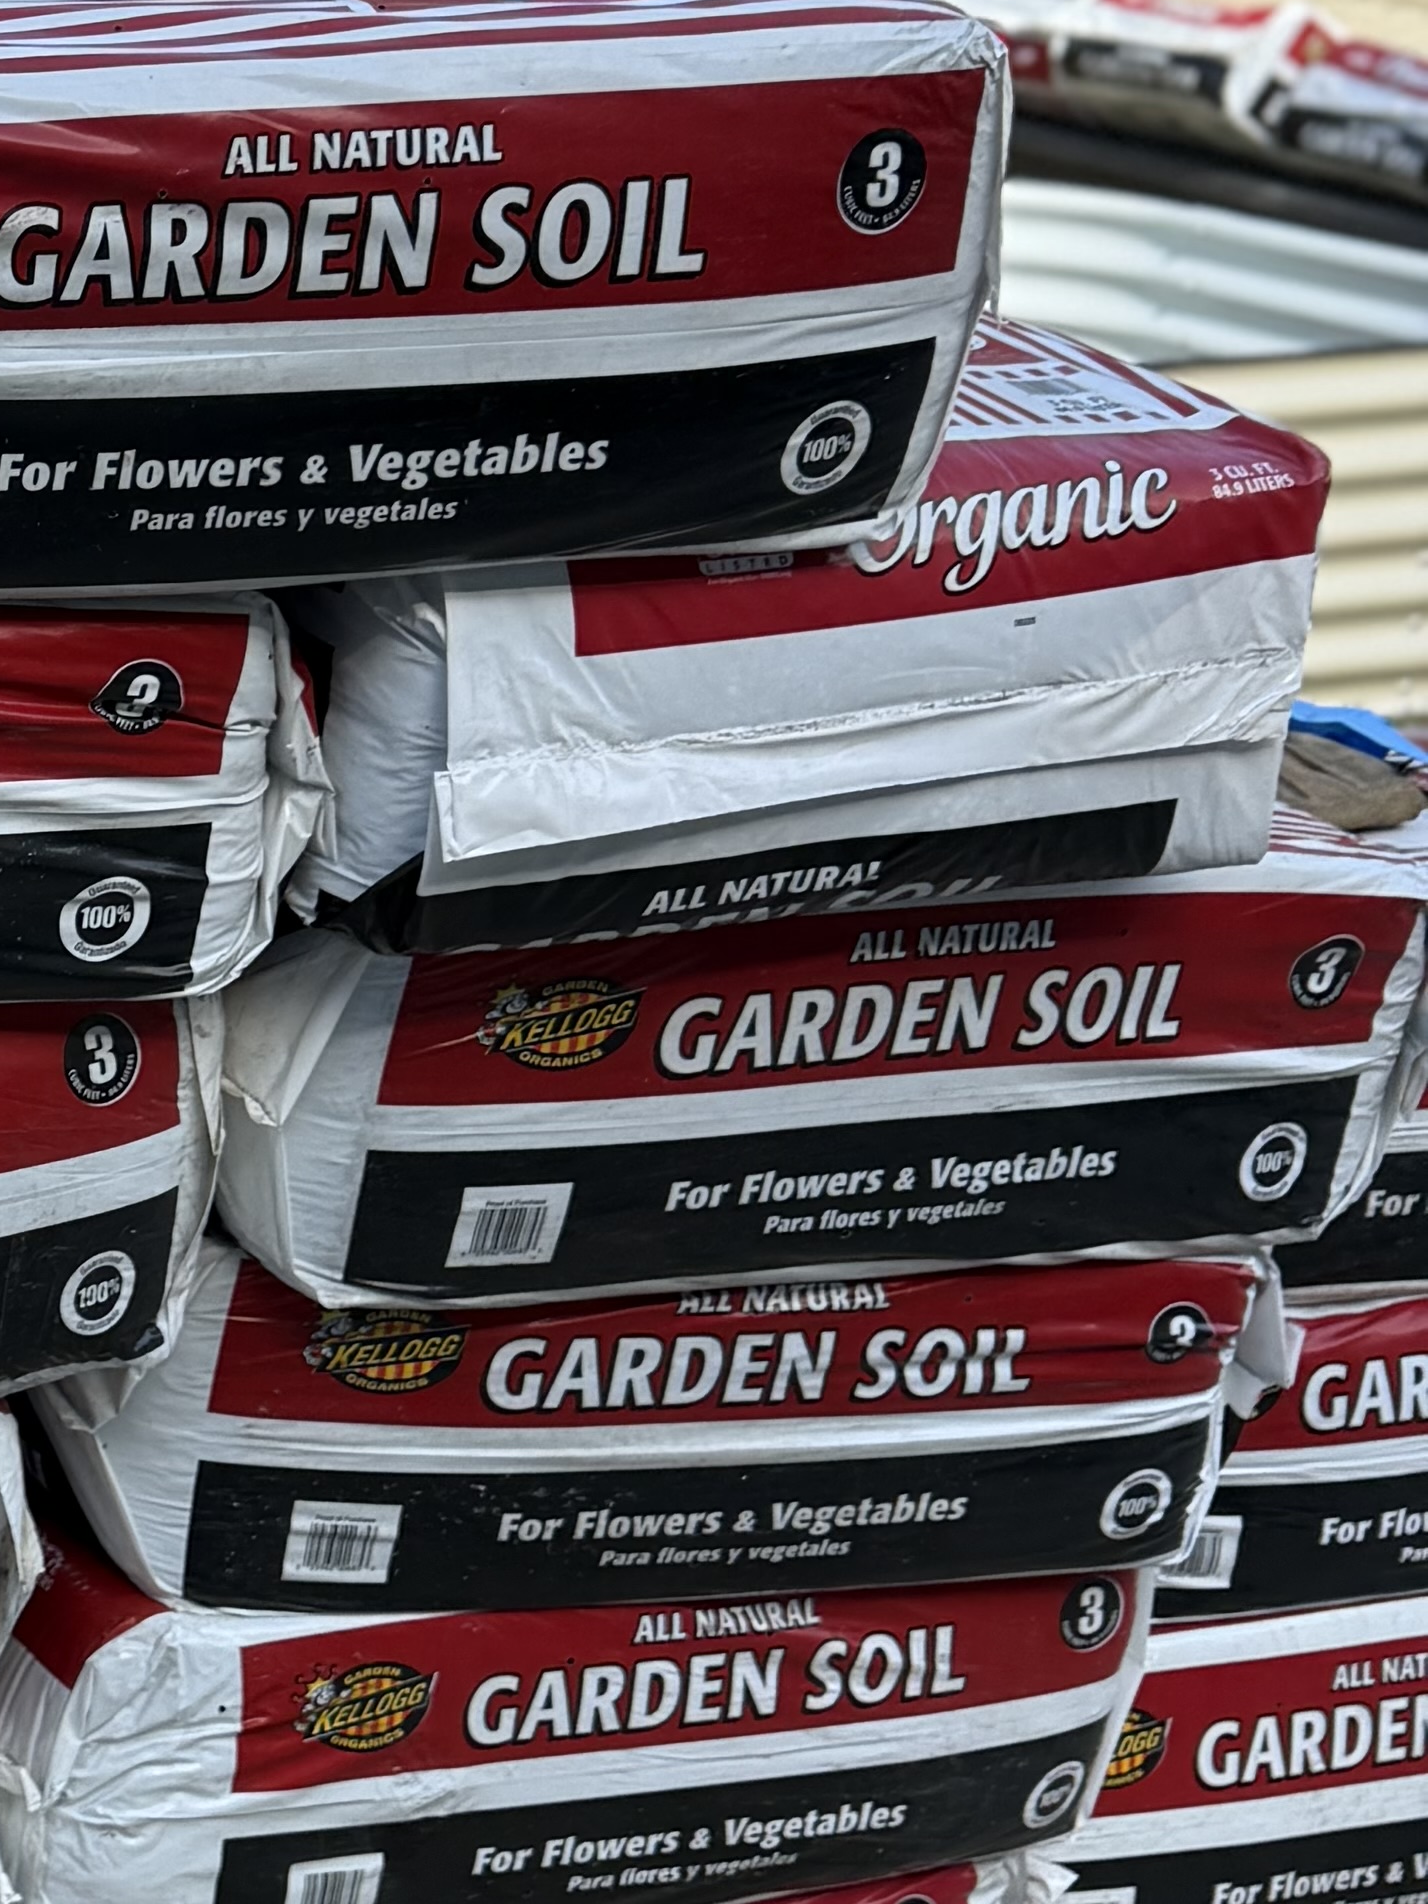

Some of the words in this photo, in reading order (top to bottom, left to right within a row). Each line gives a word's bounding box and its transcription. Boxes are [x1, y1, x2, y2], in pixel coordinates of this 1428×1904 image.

[225, 135, 297, 174] ALL
[314, 125, 502, 169] NATURAL
[867, 141, 903, 208] 3
[472, 178, 703, 284] SOIL
[91, 449, 283, 490] Flowers
[300, 455, 328, 484] &
[350, 432, 608, 490] Vegetables
[802, 434, 851, 464] 100%
[1247, 473, 1295, 495] LITERS
[130, 509, 194, 531] Para
[205, 506, 287, 528] flores
[298, 509, 314, 531] y
[325, 497, 458, 529] vegetales
[642, 886, 705, 916] ALL
[718, 861, 880, 909] NATURAL
[849, 931, 907, 964] ALL
[917, 918, 1057, 956] NATURAL
[1305, 946, 1344, 994] 3
[503, 999, 635, 1051] KELLOGG
[661, 975, 1003, 1073] GARDEN
[1018, 965, 1180, 1045] SOIL
[83, 1024, 116, 1086] 3
[1364, 1189, 1421, 1218] For
[487, 1331, 836, 1409] GARDEN
[498, 1513, 564, 1541] For
[573, 1509, 723, 1539] Flowers
[733, 1511, 755, 1532] &
[773, 1493, 968, 1535] Vegetables
[634, 1613, 686, 1642] ALL
[696, 1600, 821, 1637] NATURAL
[468, 1649, 784, 1744] GARDEN
[806, 1626, 964, 1709] SOIL
[1332, 1661, 1375, 1690] ALL
[1267, 1864, 1380, 1902] Flowers
